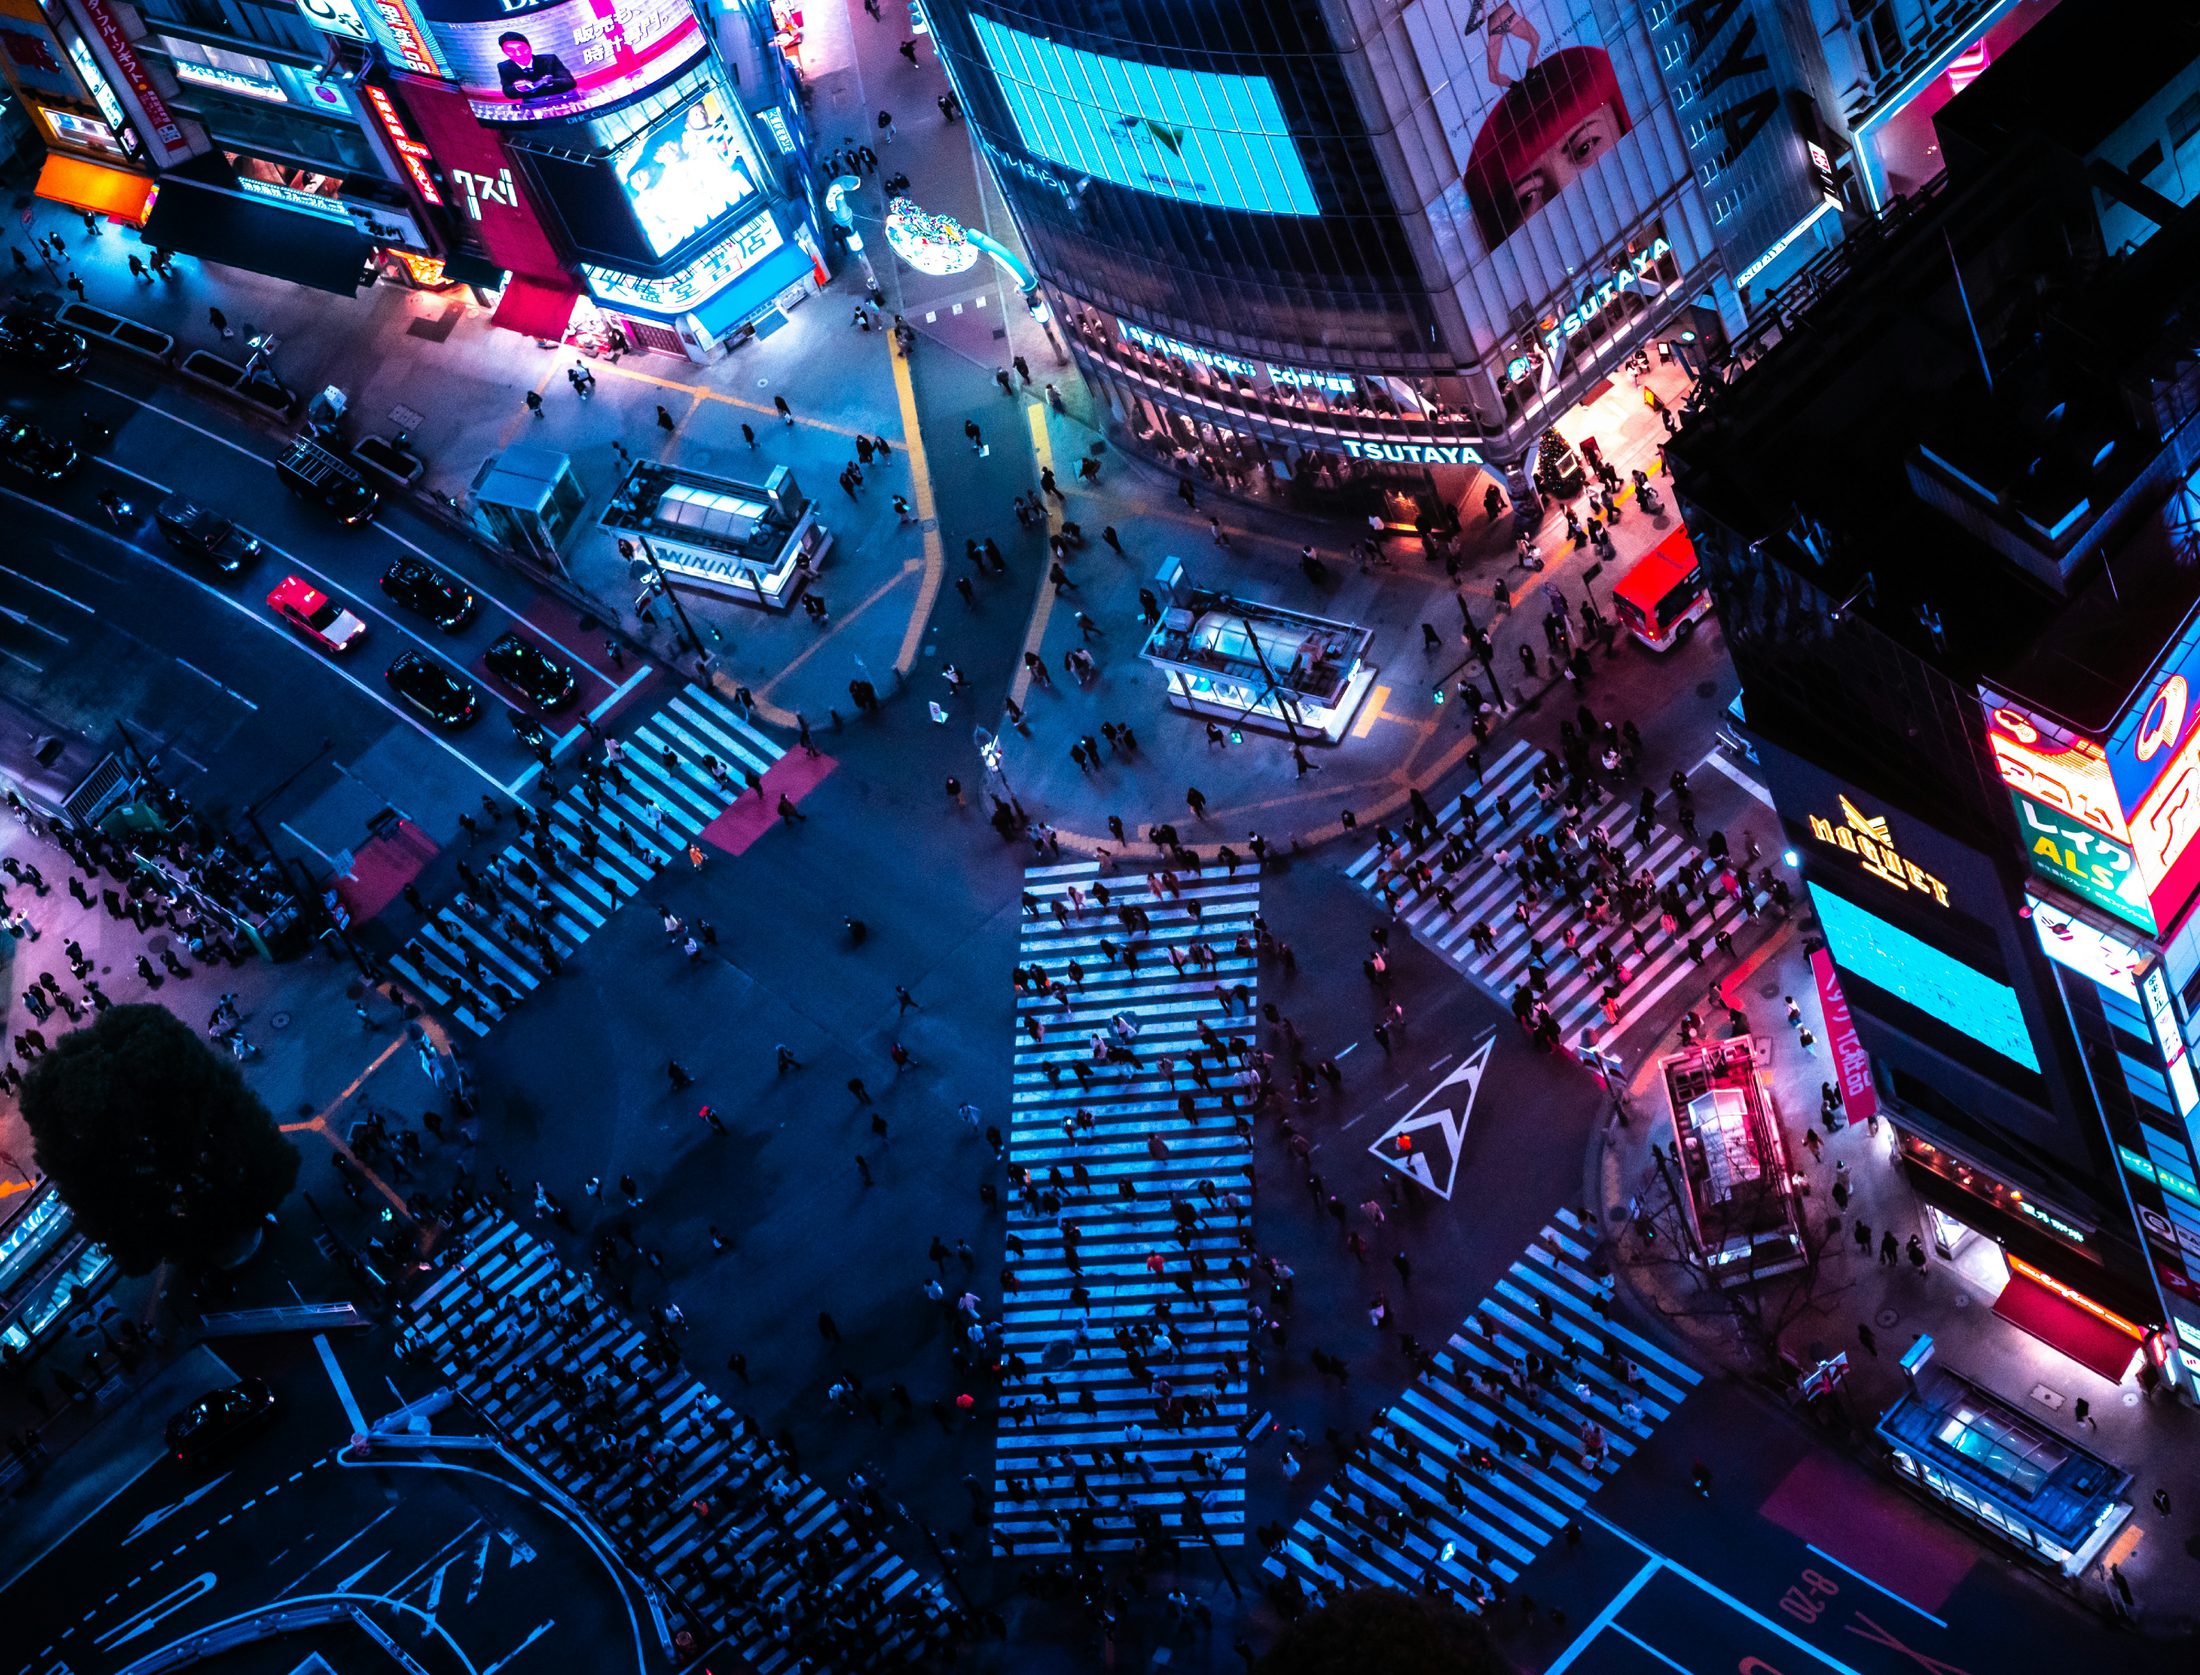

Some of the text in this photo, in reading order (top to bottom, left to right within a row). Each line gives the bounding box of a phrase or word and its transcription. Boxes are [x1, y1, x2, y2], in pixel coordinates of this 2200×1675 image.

[566, 99, 632, 125] DHC Channel
[598, 214, 772, 304] 大盛堂書店
[1545, 237, 1670, 350] TSUTAYA
[1129, 327, 1356, 393] STARBUCKS COFFEE
[1342, 440, 1484, 464] TSUTAYA
[2022, 799, 2132, 872] レイク
[1779, 1567, 1841, 1625] 8-20
